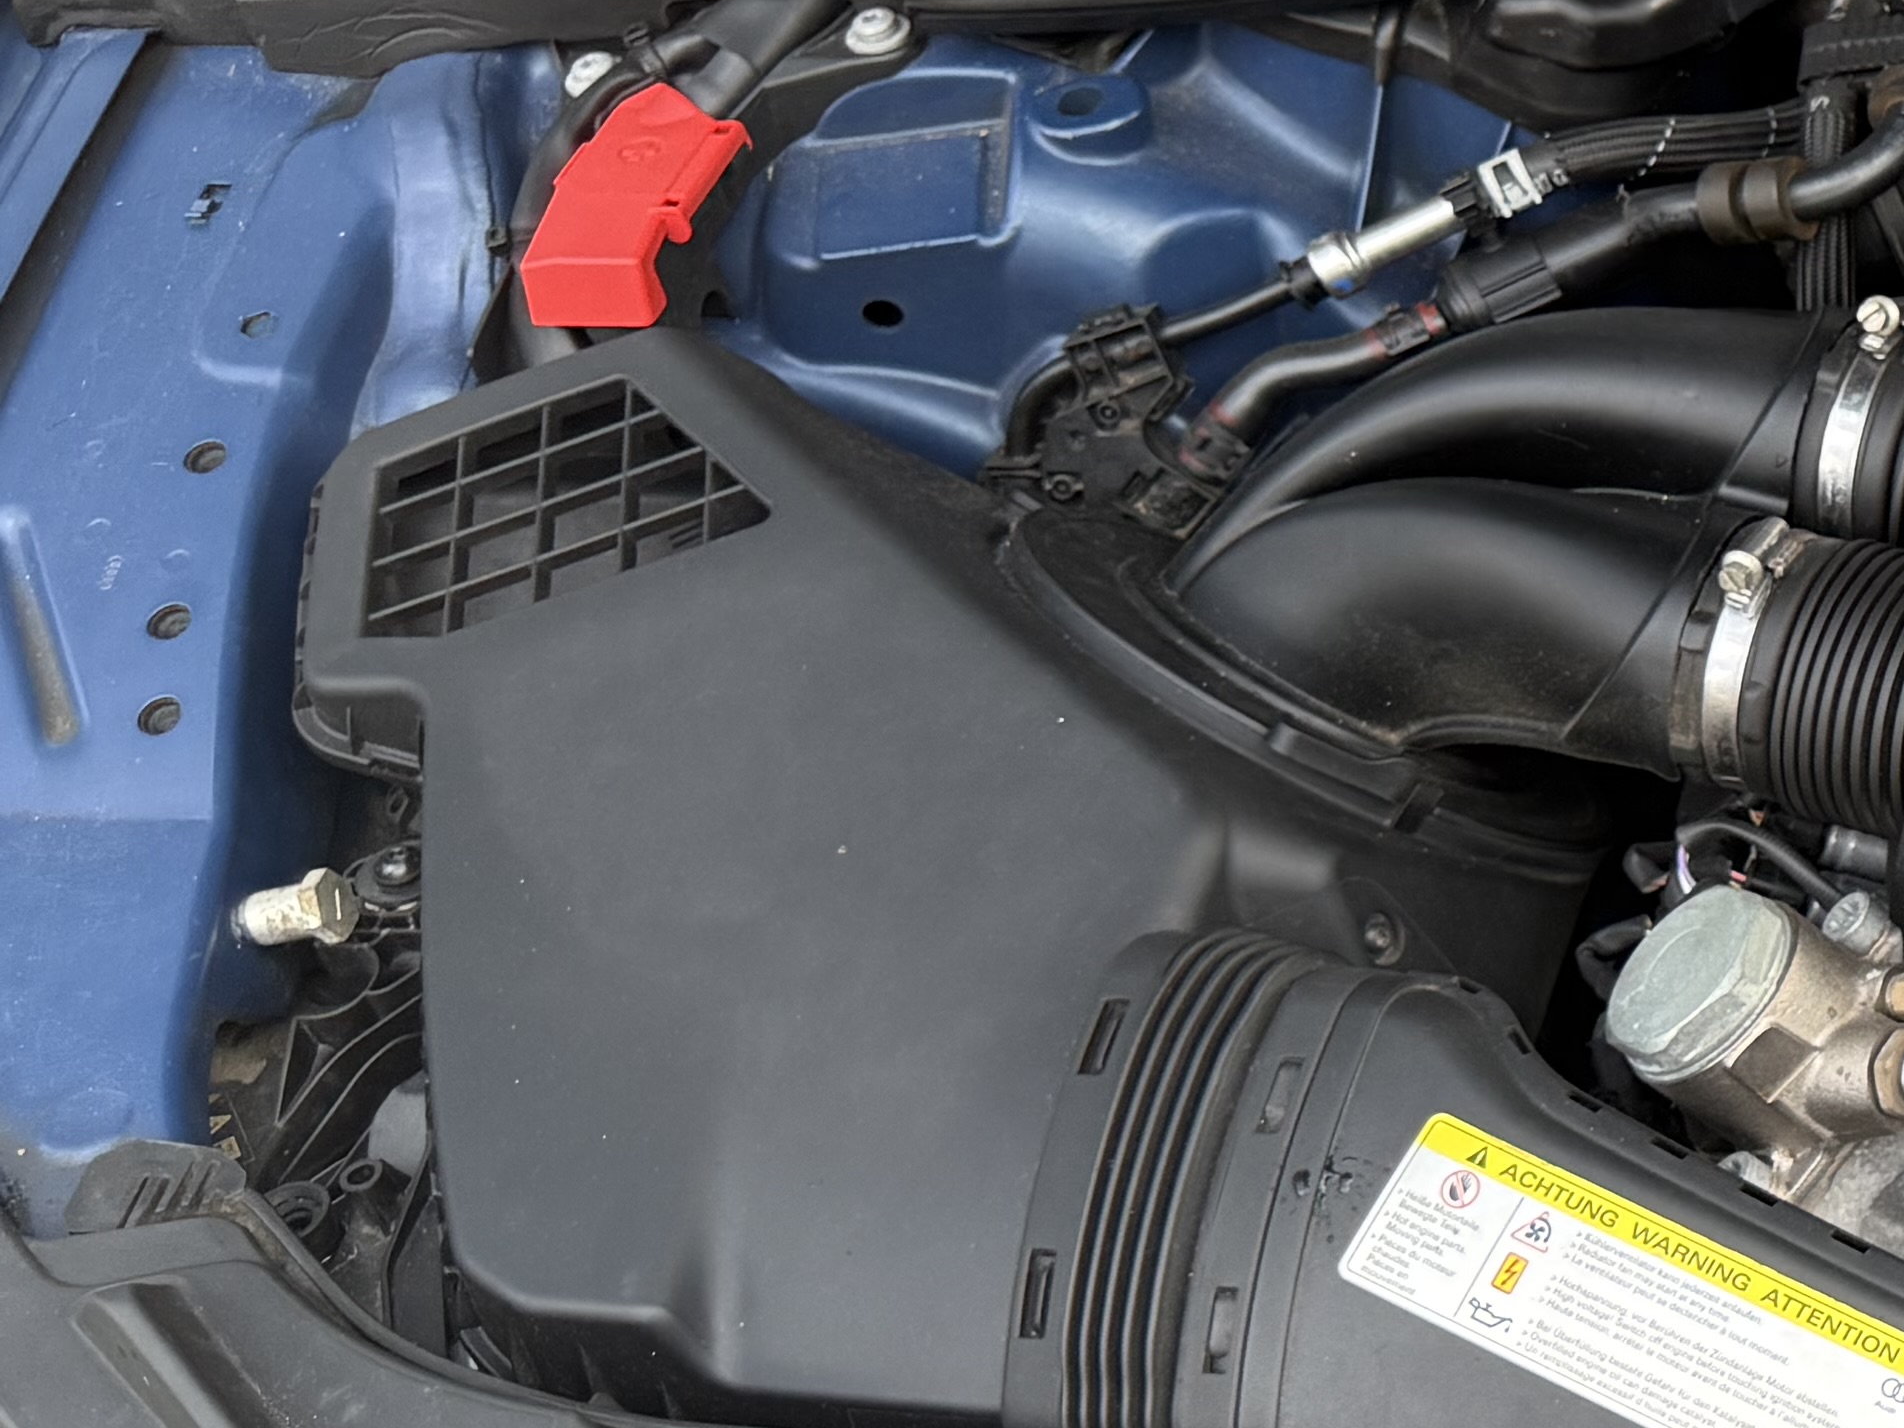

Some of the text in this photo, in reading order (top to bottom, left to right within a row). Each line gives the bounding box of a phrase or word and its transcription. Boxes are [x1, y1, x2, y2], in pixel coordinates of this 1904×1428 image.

[1498, 1163, 1900, 1363] ACHTUNG WARNING ATTENTION
